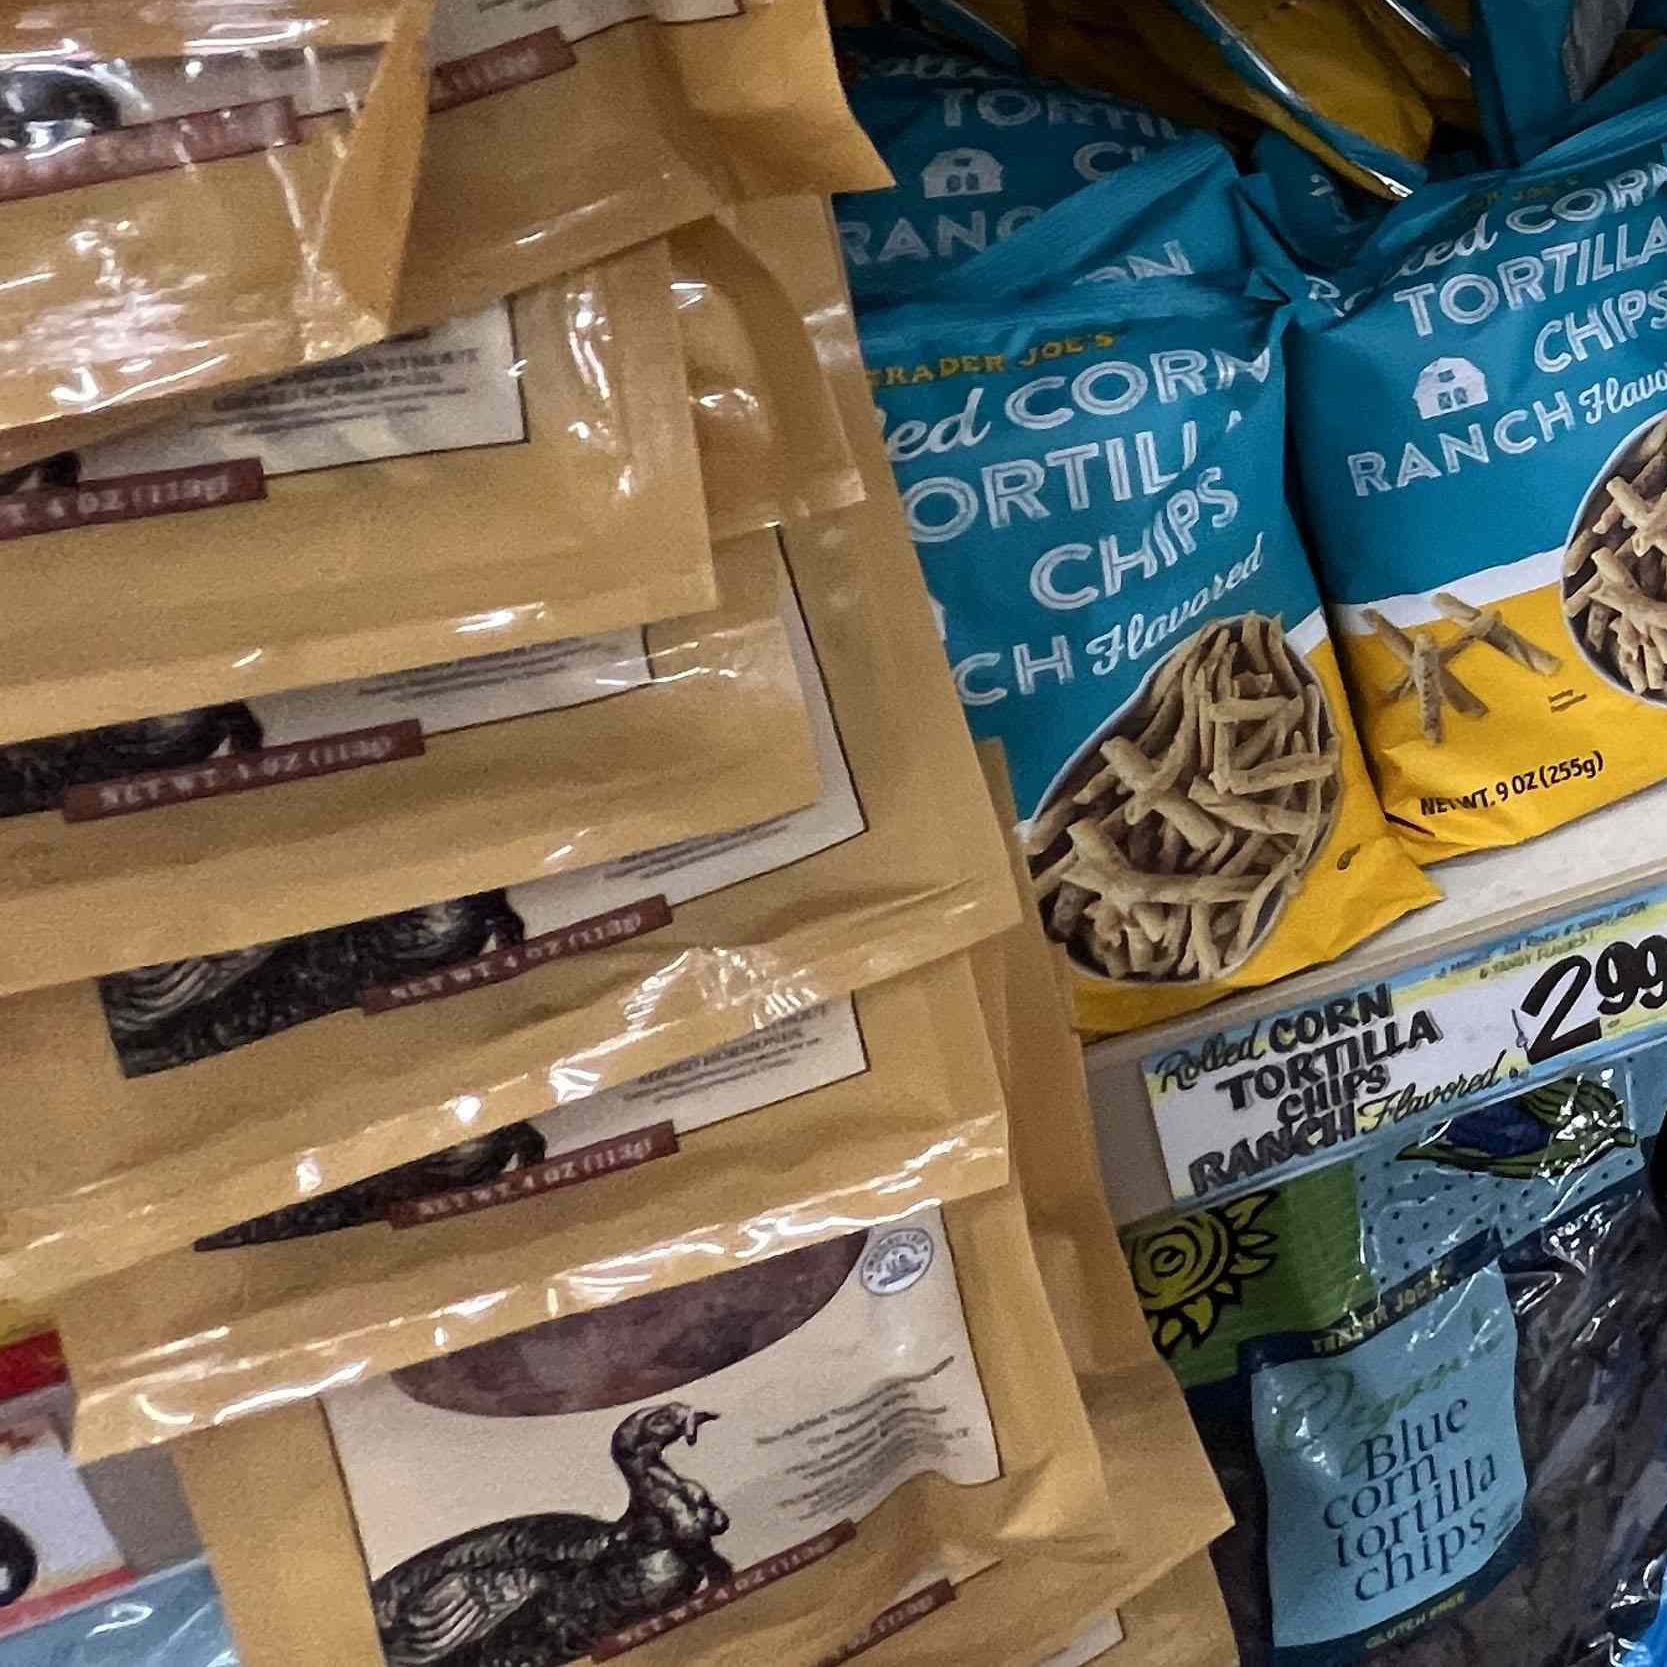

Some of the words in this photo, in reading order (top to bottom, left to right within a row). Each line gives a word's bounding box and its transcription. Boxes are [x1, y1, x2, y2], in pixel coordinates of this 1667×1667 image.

[1004, 348, 1272, 430] CORN
[1347, 391, 1577, 497] RANCH
[1029, 465, 1239, 612] CHIPS
[1085, 531, 1265, 678] Flavored
[1513, 769, 1536, 797] OZ
[1537, 749, 1604, 792] (255g)
[1154, 1020, 1268, 1094] Rolled
[1269, 982, 1396, 1055] CORN
[1216, 1010, 1444, 1112] TORTILLA
[1188, 1102, 1357, 1196] RANCH
[1358, 1050, 1507, 1135] Flavored
[1276, 1063, 1392, 1131] CHIPS
[1361, 1394, 1472, 1484] Blue
[1320, 1452, 1441, 1533] corn
[1333, 1452, 1499, 1570] tortilla
[1353, 1505, 1488, 1604] chips
